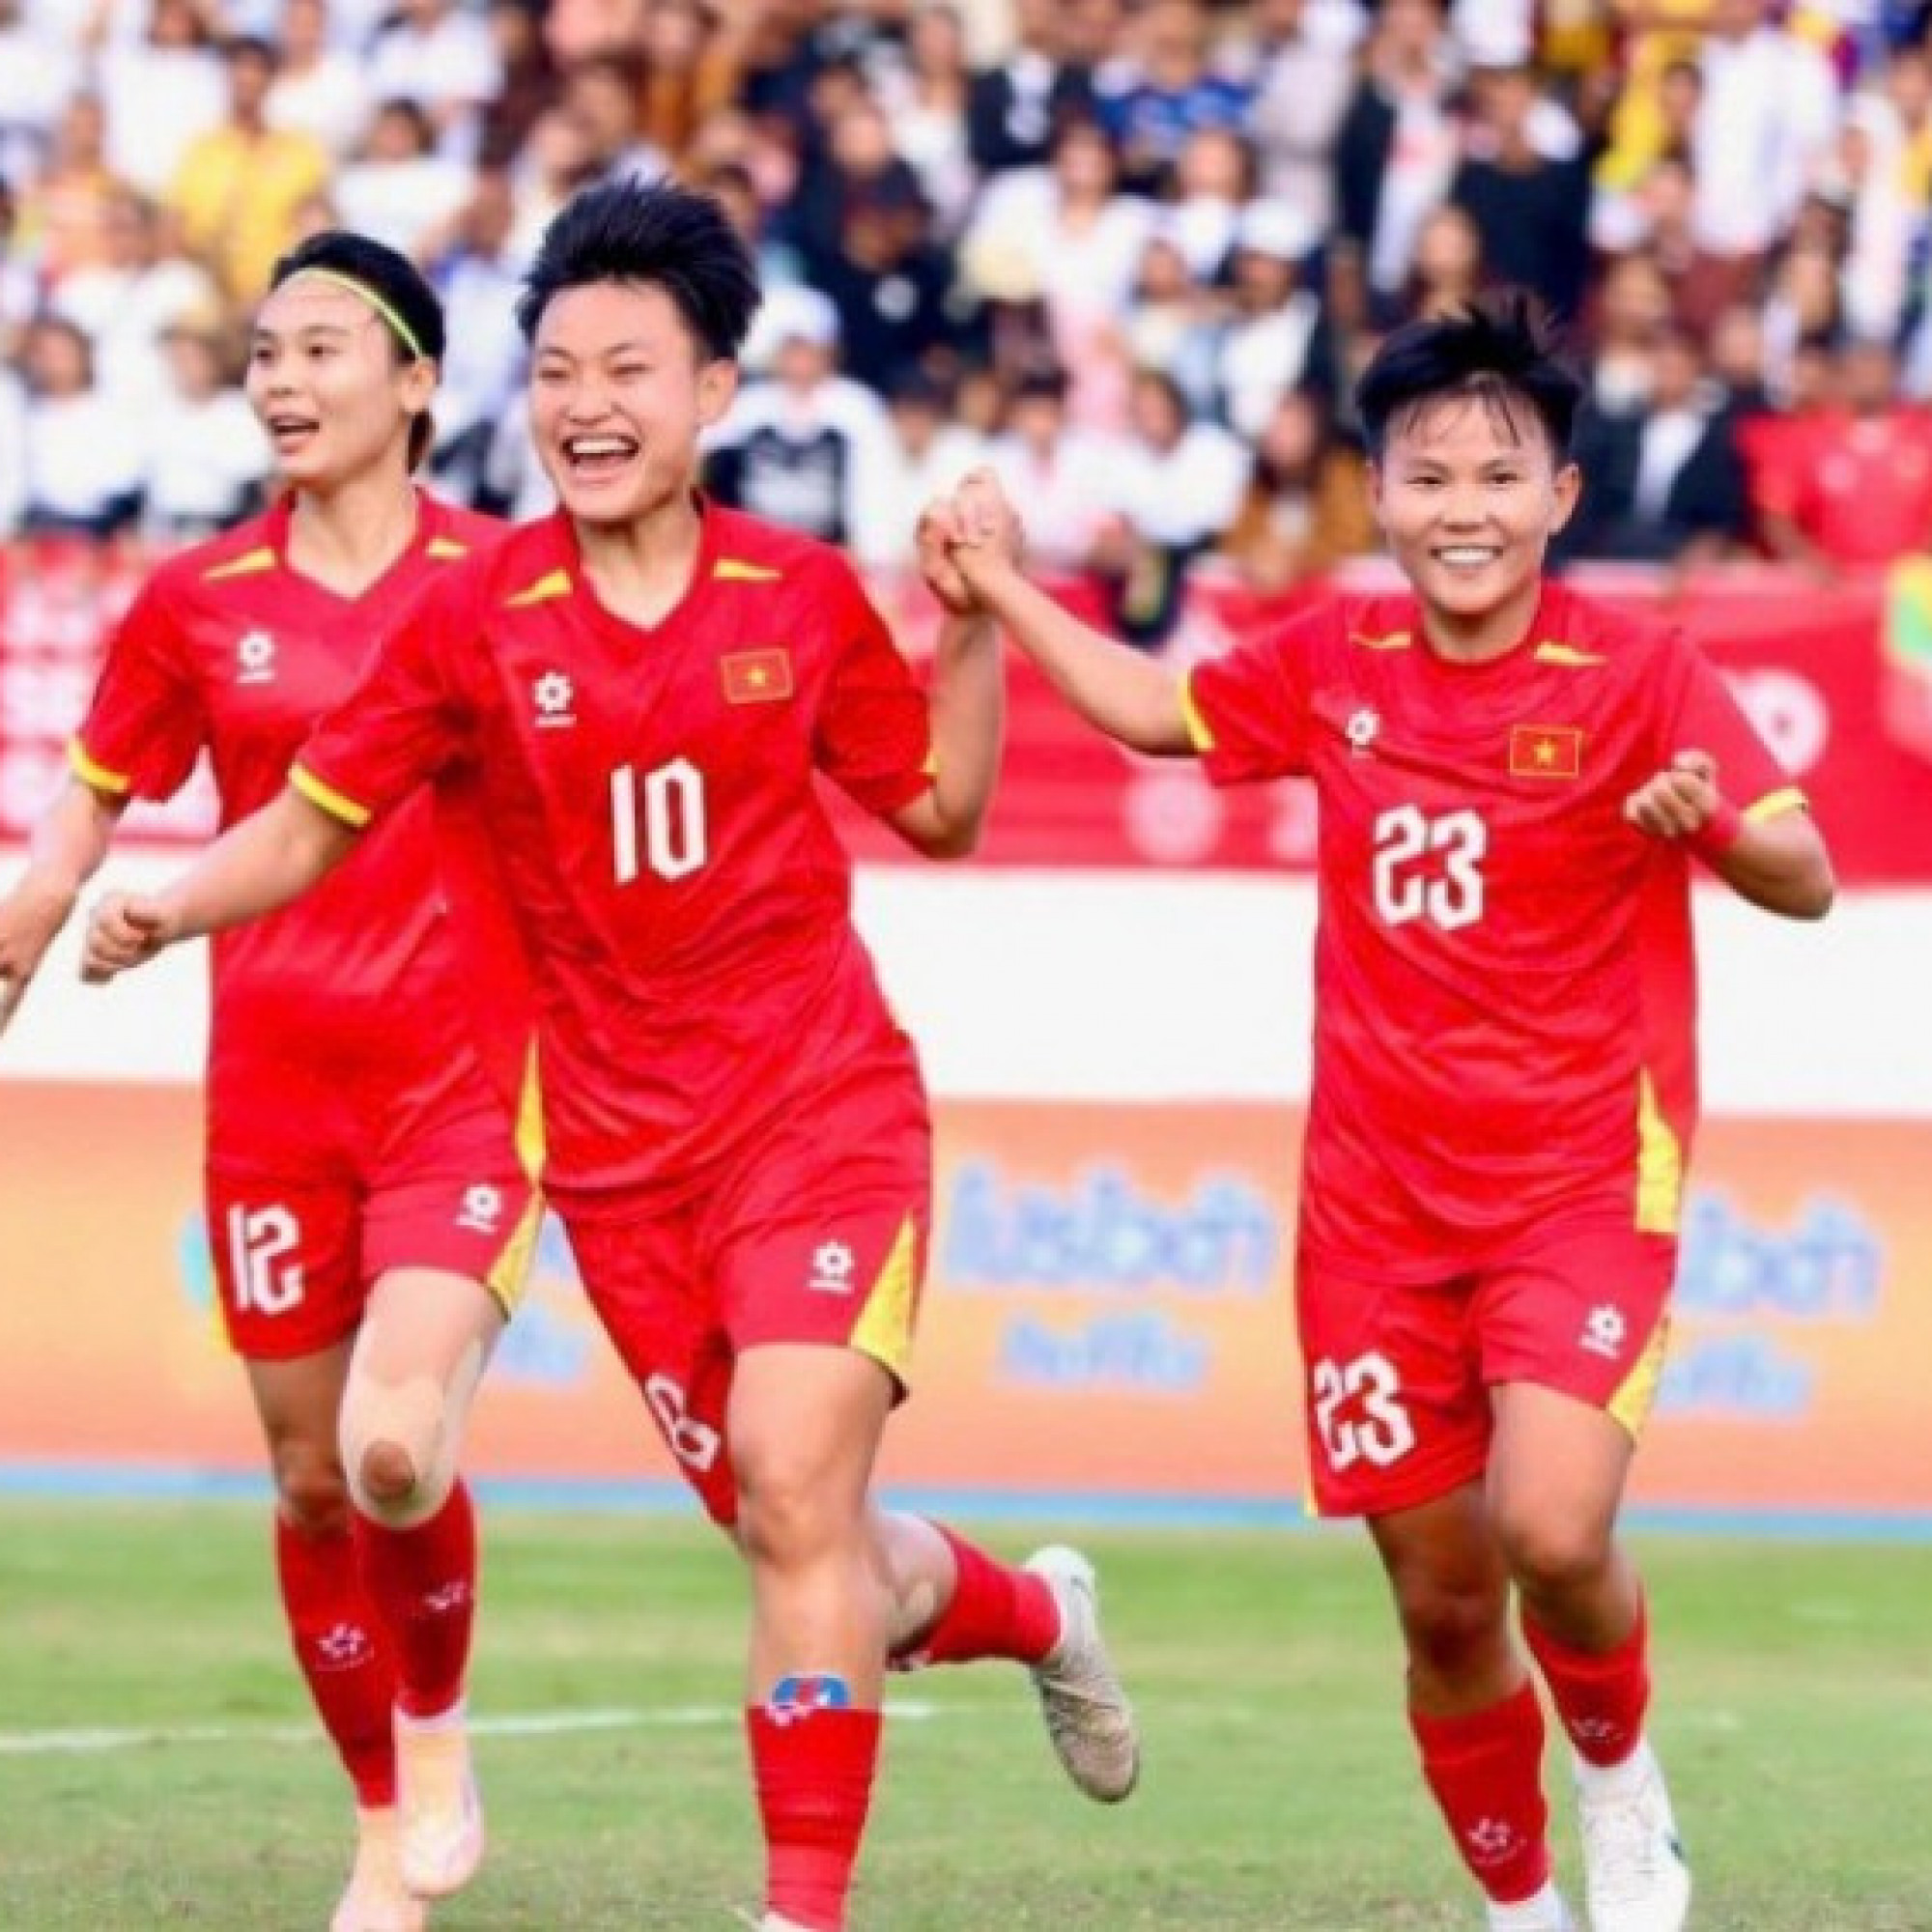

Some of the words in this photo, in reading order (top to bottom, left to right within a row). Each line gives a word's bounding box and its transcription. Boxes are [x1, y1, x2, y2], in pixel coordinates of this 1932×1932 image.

[610, 756, 707, 886] 10
[1373, 805, 1487, 929] 23
[227, 1203, 305, 1314] 12
[1314, 1351, 1415, 1472] 23
